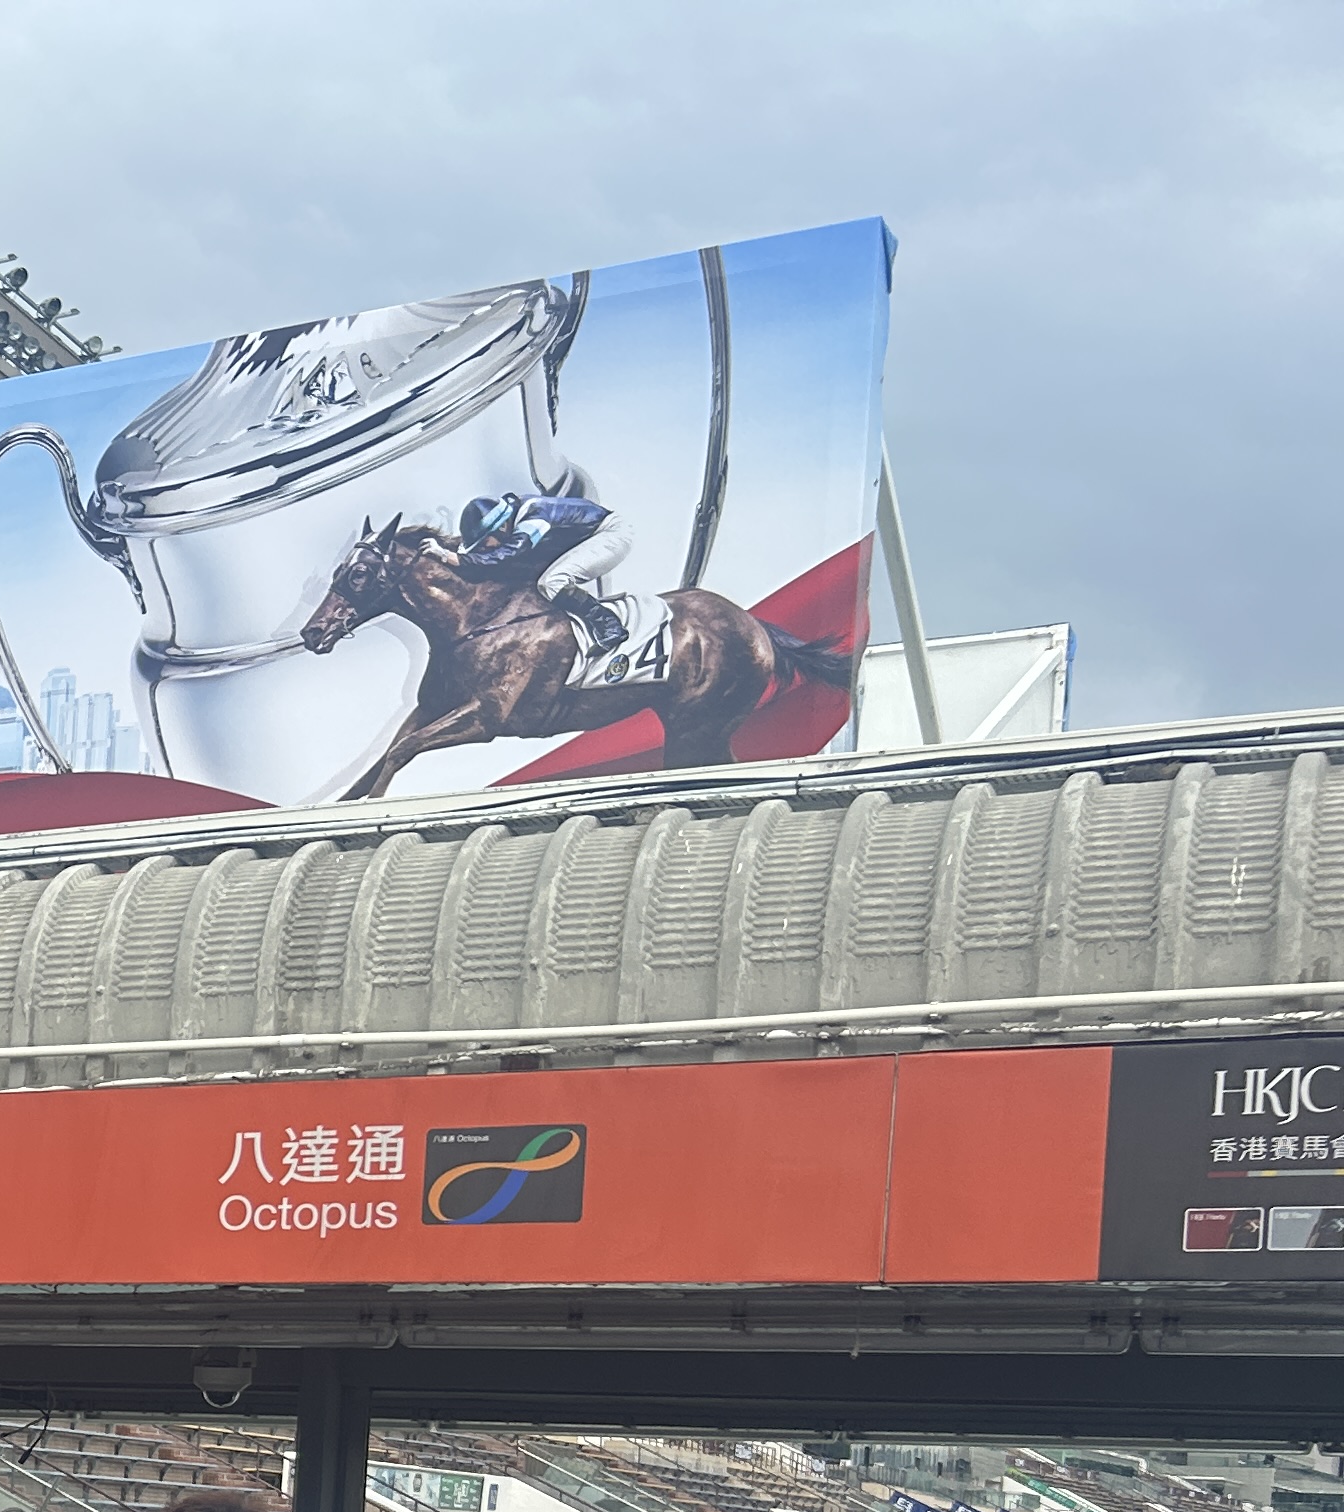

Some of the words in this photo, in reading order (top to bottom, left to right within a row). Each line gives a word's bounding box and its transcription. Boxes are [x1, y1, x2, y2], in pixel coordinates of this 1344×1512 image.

[635, 621, 669, 679] 4
[1211, 1064, 1342, 1126] HKJC
[218, 1123, 406, 1186] 八達通
[219, 1194, 398, 1238] Octopus
